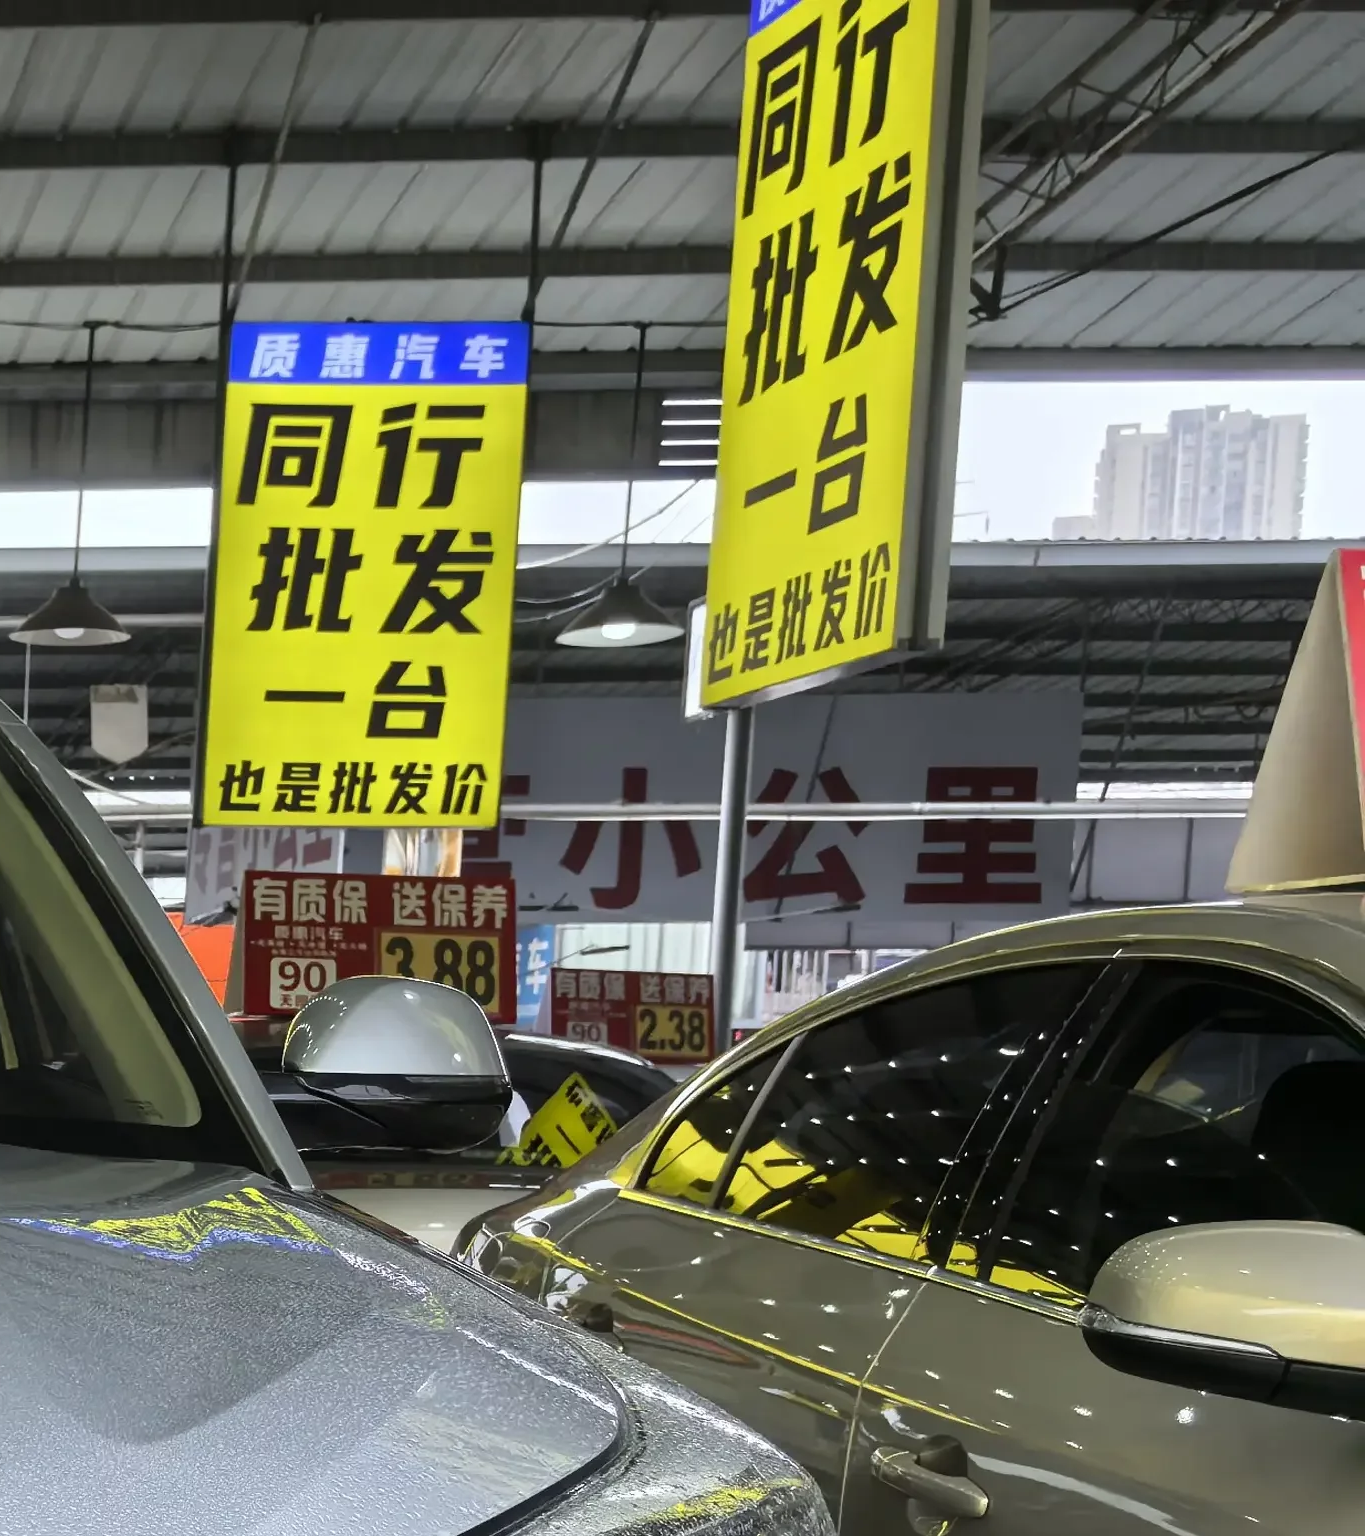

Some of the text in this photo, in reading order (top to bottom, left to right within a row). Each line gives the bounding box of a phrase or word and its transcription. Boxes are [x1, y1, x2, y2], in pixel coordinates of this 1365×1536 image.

[741, 0, 910, 219] 同行
[738, 151, 912, 407] 批发
[249, 333, 509, 379] 质惠汽车
[235, 403, 486, 508] 同行
[744, 393, 869, 535] 一台
[245, 527, 495, 634] 批发
[707, 542, 891, 685] 也是批发价
[263, 661, 446, 739] 一台
[218, 760, 487, 815] 也是批发价
[253, 877, 508, 929] 有质保 送保养
[278, 960, 326, 992] 90
[639, 1009, 705, 1052] 2.38
